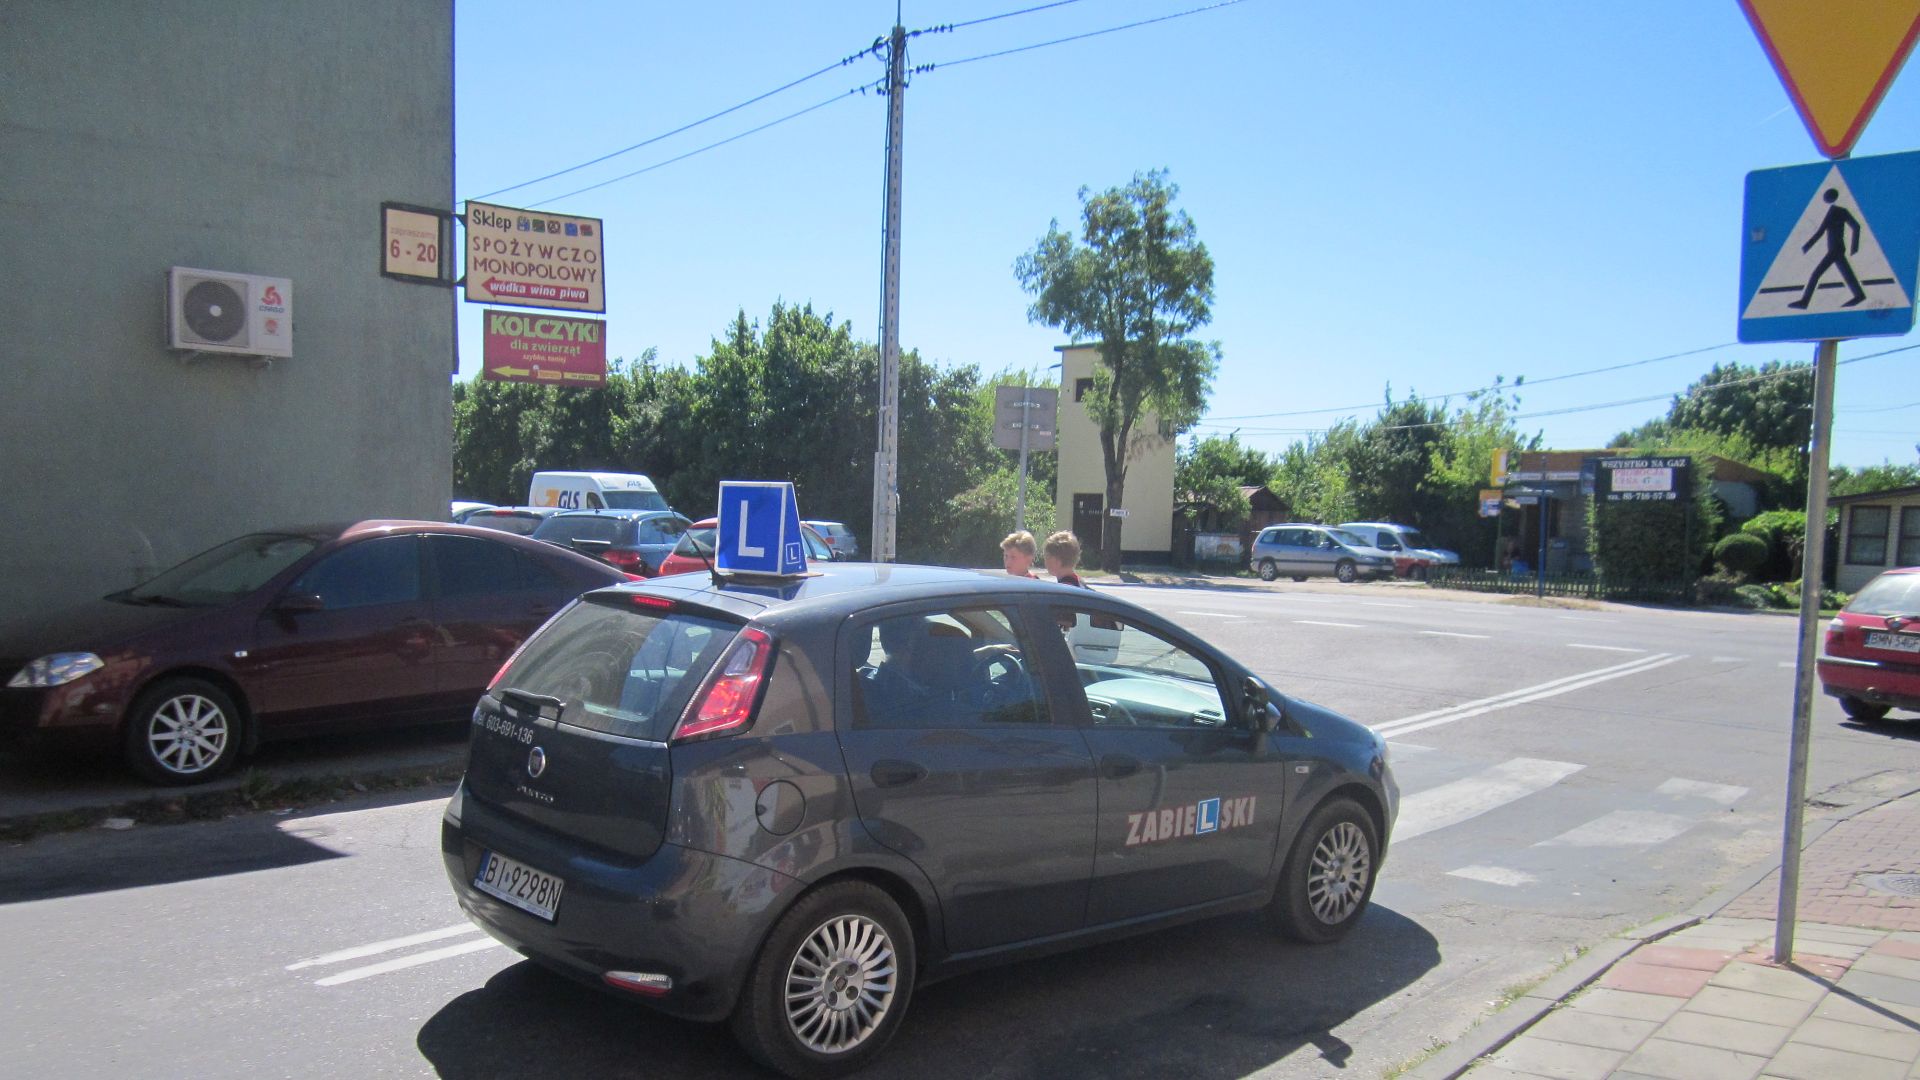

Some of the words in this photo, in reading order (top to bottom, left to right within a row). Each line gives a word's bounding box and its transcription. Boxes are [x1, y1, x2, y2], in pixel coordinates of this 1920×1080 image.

[472, 209, 511, 232] Sklep
[390, 239, 400, 258] 6
[416, 242, 436, 263] 20
[472, 236, 597, 264] SPOŻYWCZO
[472, 256, 597, 283] MONOPOLOWY
[489, 280, 526, 294] wódka
[530, 285, 556, 297] wino
[560, 286, 586, 300] piwo
[490, 314, 598, 343] KOLCZYKI
[510, 340, 528, 351] dla
[532, 342, 580, 357] zwierząt
[1602, 460, 1648, 468] WSZYSTKO
[1652, 460, 1664, 468] NA
[1667, 458, 1686, 467] GAZ
[558, 490, 580, 509] GLS
[738, 500, 764, 557] L
[790, 547, 797, 560] L
[487, 714, 534, 744] 603-691-136
[1125, 795, 1257, 846] ZABIELSKI
[508, 866, 562, 911] 9298N
